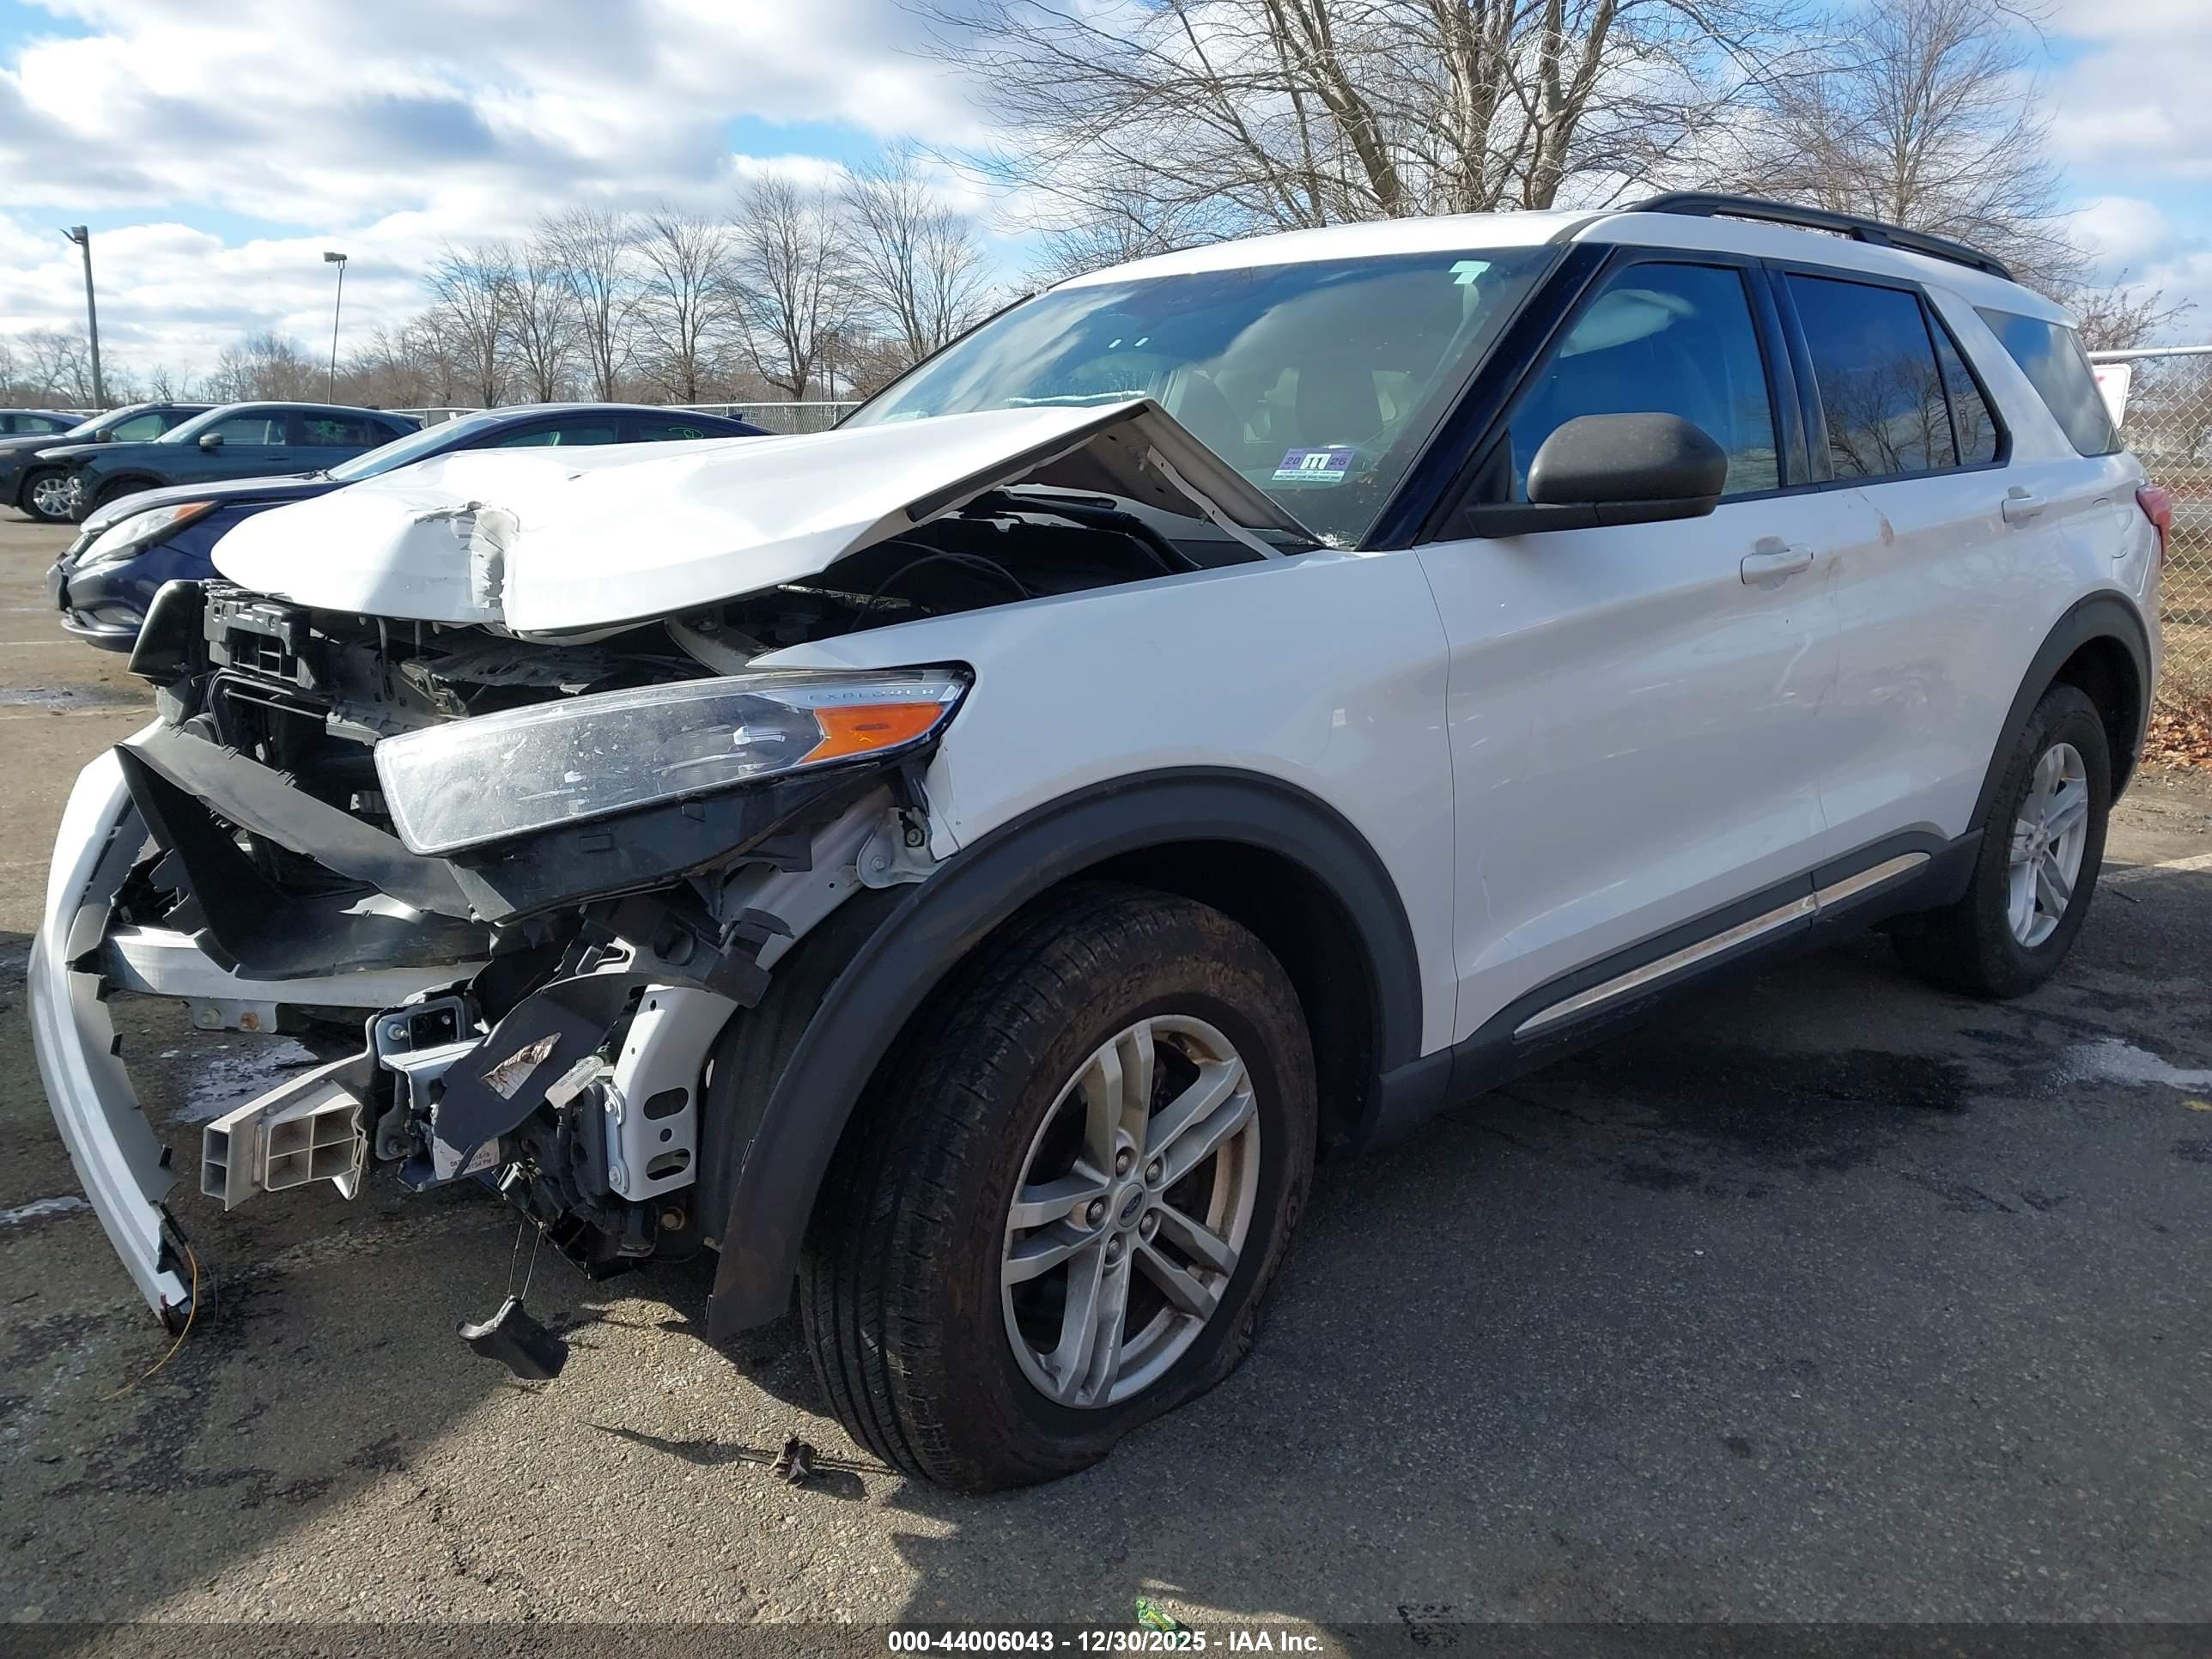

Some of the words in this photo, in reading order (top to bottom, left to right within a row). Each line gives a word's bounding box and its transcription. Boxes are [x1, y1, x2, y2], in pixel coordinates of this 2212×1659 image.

[1284, 456, 1302, 465] 20
[1304, 456, 1323, 469] 11
[1329, 457, 1348, 465] 26
